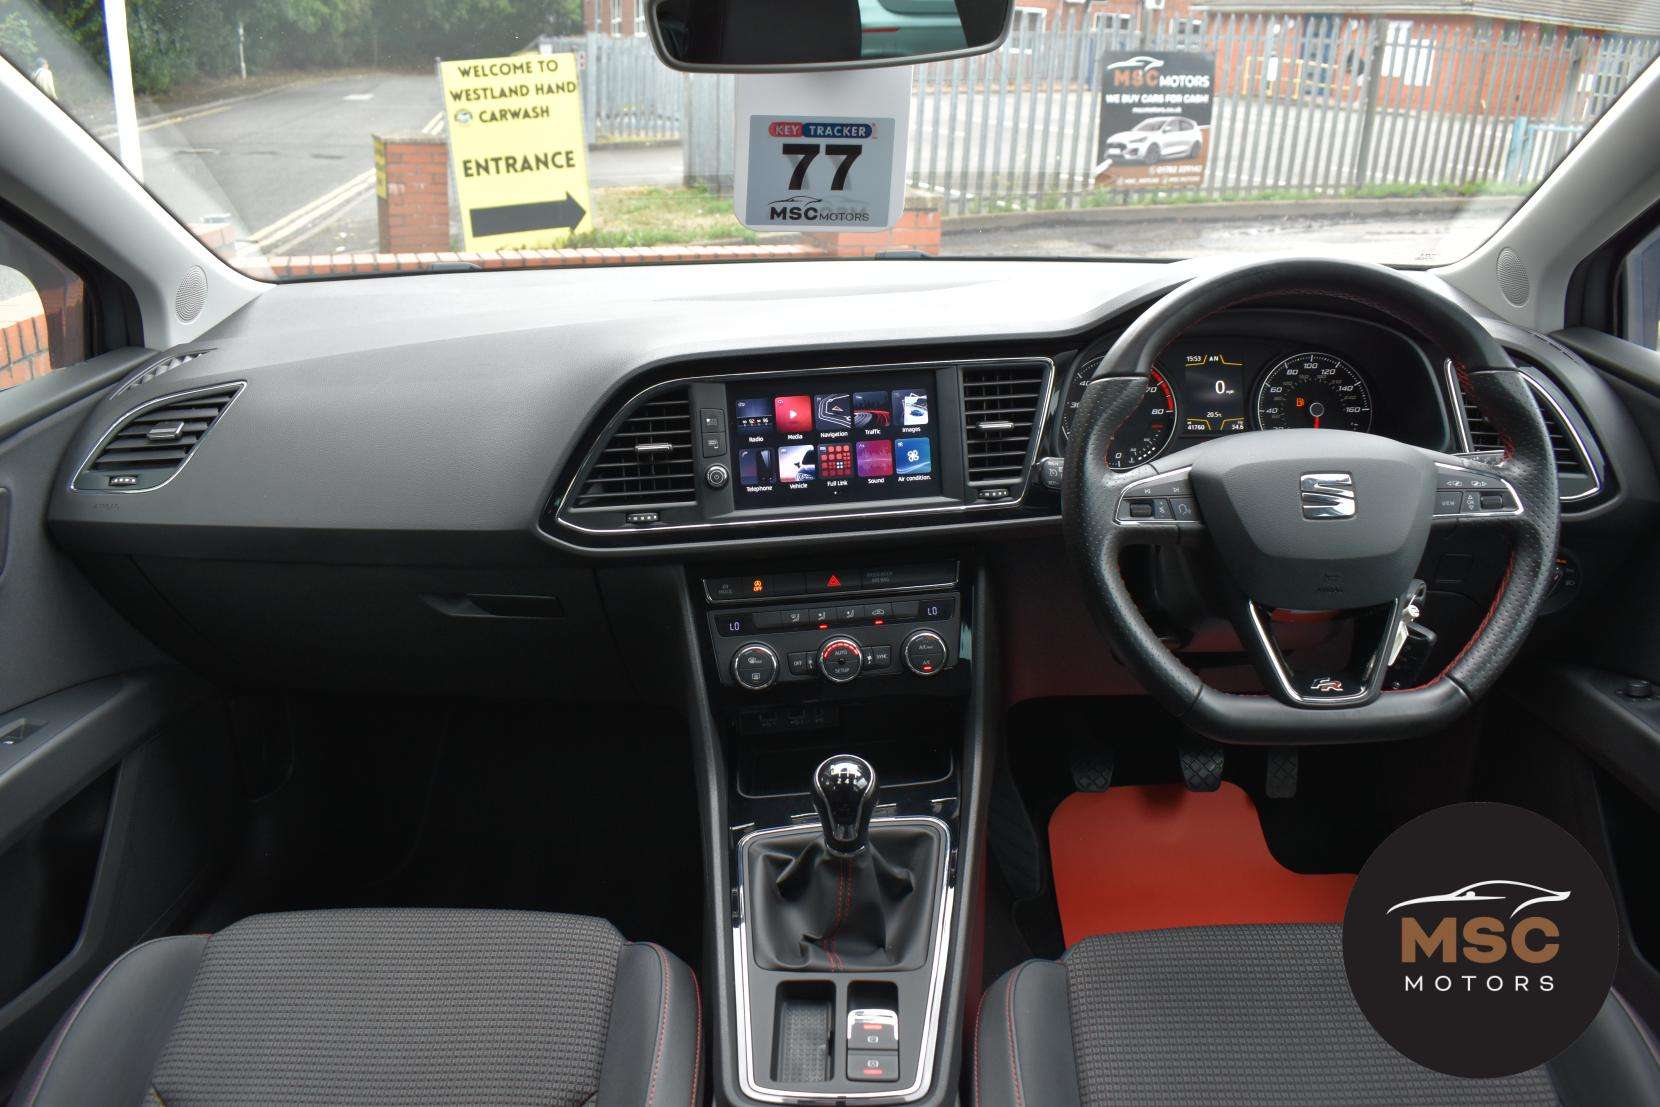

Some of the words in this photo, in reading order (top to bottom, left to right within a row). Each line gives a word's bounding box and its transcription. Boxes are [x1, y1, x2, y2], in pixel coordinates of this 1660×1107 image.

[458, 62, 533, 78] WELCOME
[538, 60, 558, 72] TO
[1114, 69, 1159, 87] MSC
[1160, 75, 1210, 88] MOTORS
[450, 84, 530, 102] WESTLAND
[535, 81, 576, 95] HAND
[479, 106, 550, 123] CARWASH
[776, 124, 800, 136] KEY
[809, 125, 866, 137] TRACKER
[462, 150, 576, 177] ENTRANCE
[782, 144, 862, 190] 77
[770, 206, 818, 220] MSC
[818, 212, 870, 222] MOTORS
[1215, 380, 1225, 394] 0
[927, 606, 938, 616] LO
[730, 622, 740, 631] LO
